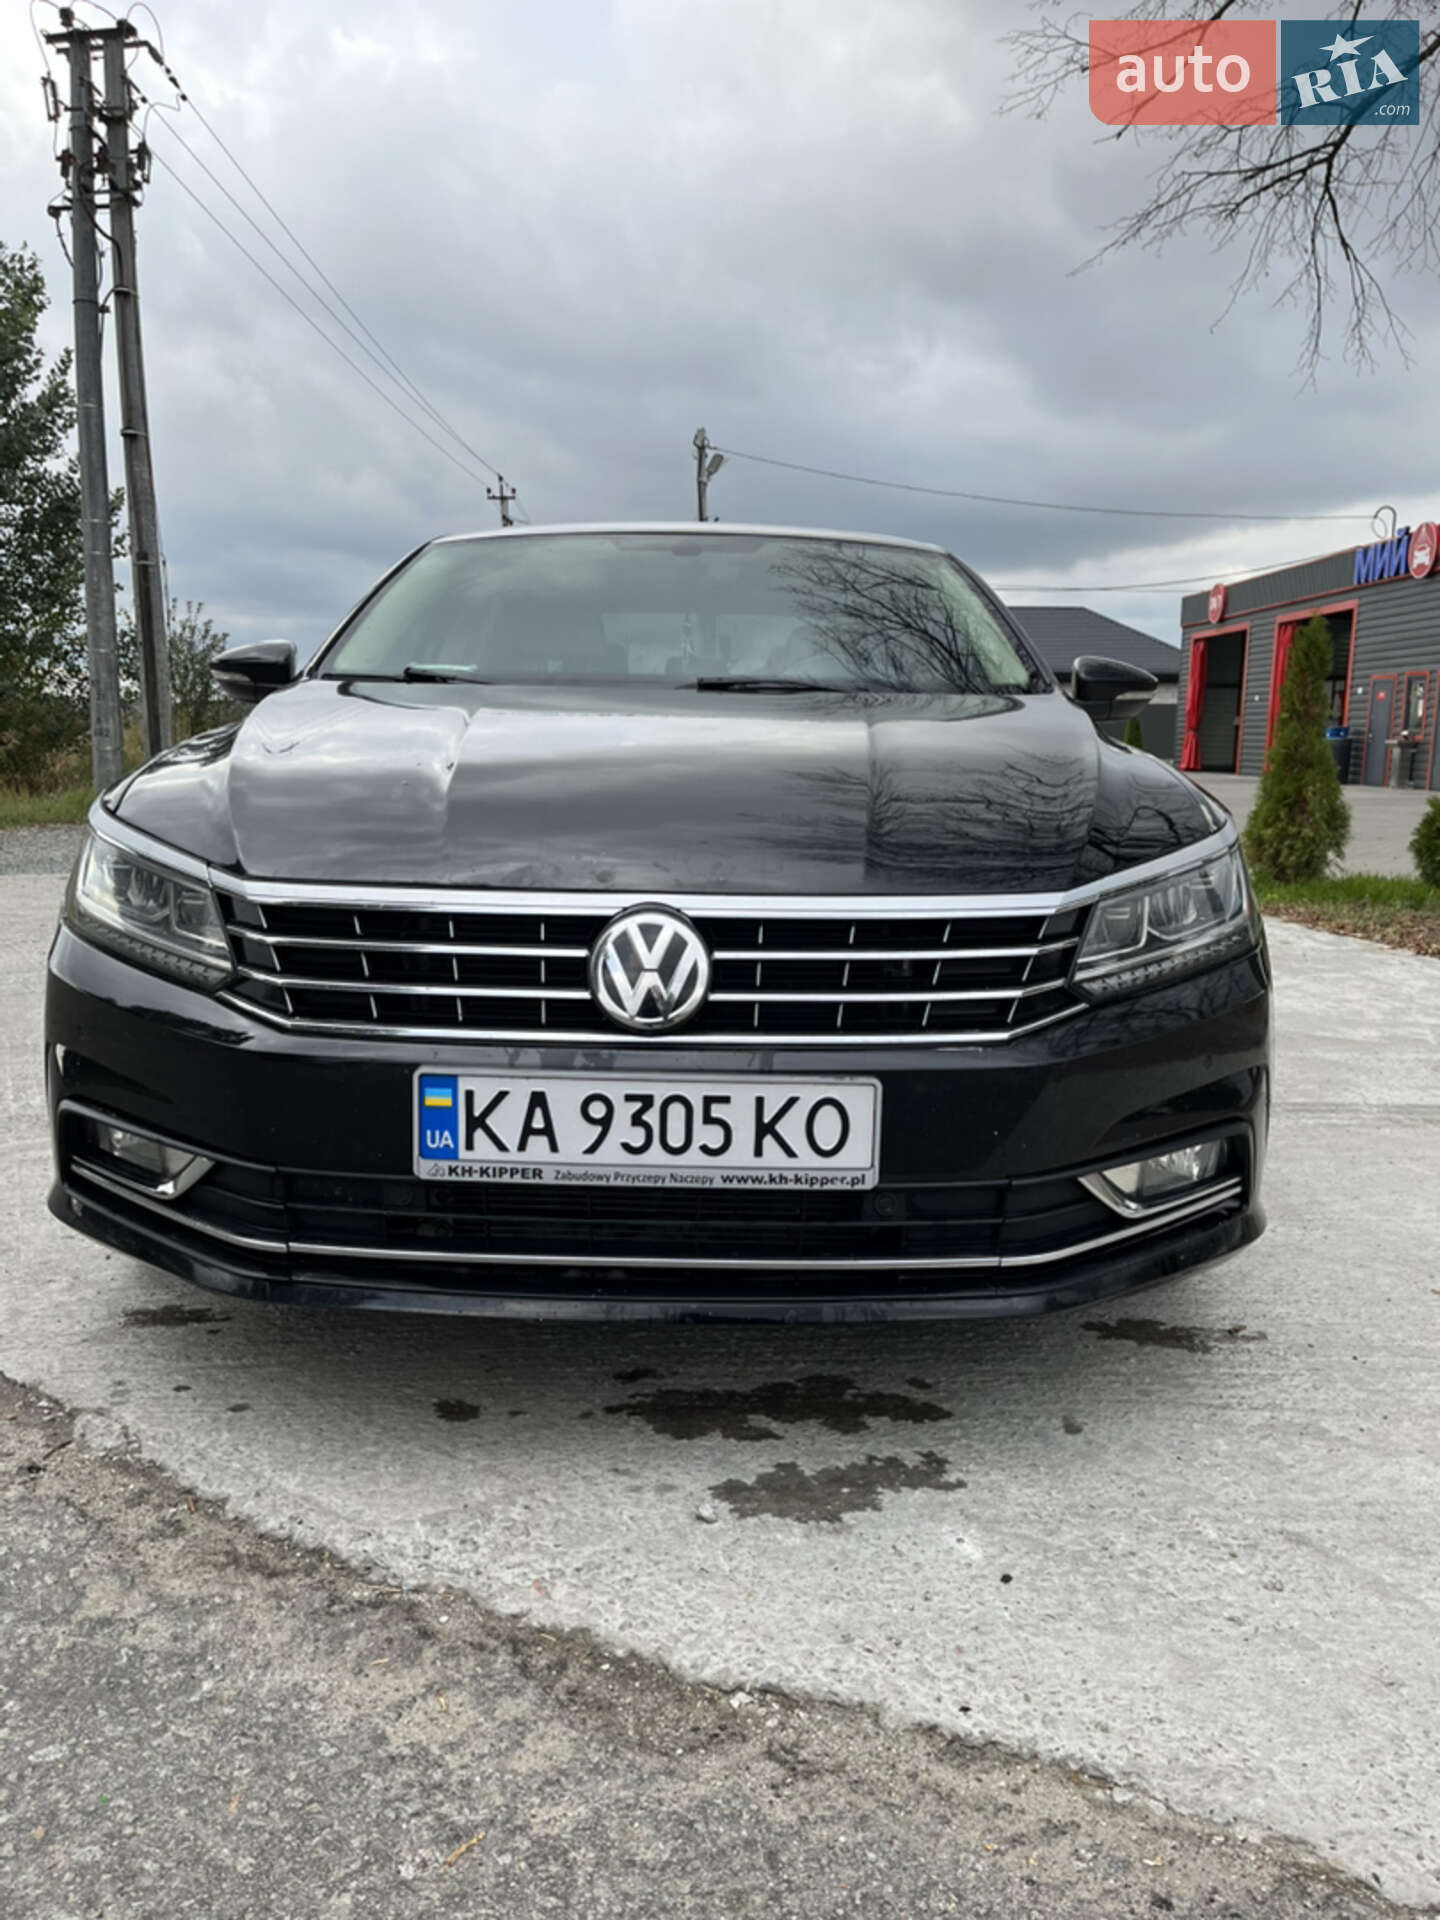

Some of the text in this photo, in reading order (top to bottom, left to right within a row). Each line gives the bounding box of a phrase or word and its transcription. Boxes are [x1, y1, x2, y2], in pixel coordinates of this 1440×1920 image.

[1353, 526, 1411, 585] МИЙ
[426, 1130, 454, 1149] UA
[464, 1089, 851, 1159] KA 9305 KO
[447, 1165, 866, 1187] KH-KIPPER Zabudowy Przyczepy Naczepy www.kh-kipper.pl
